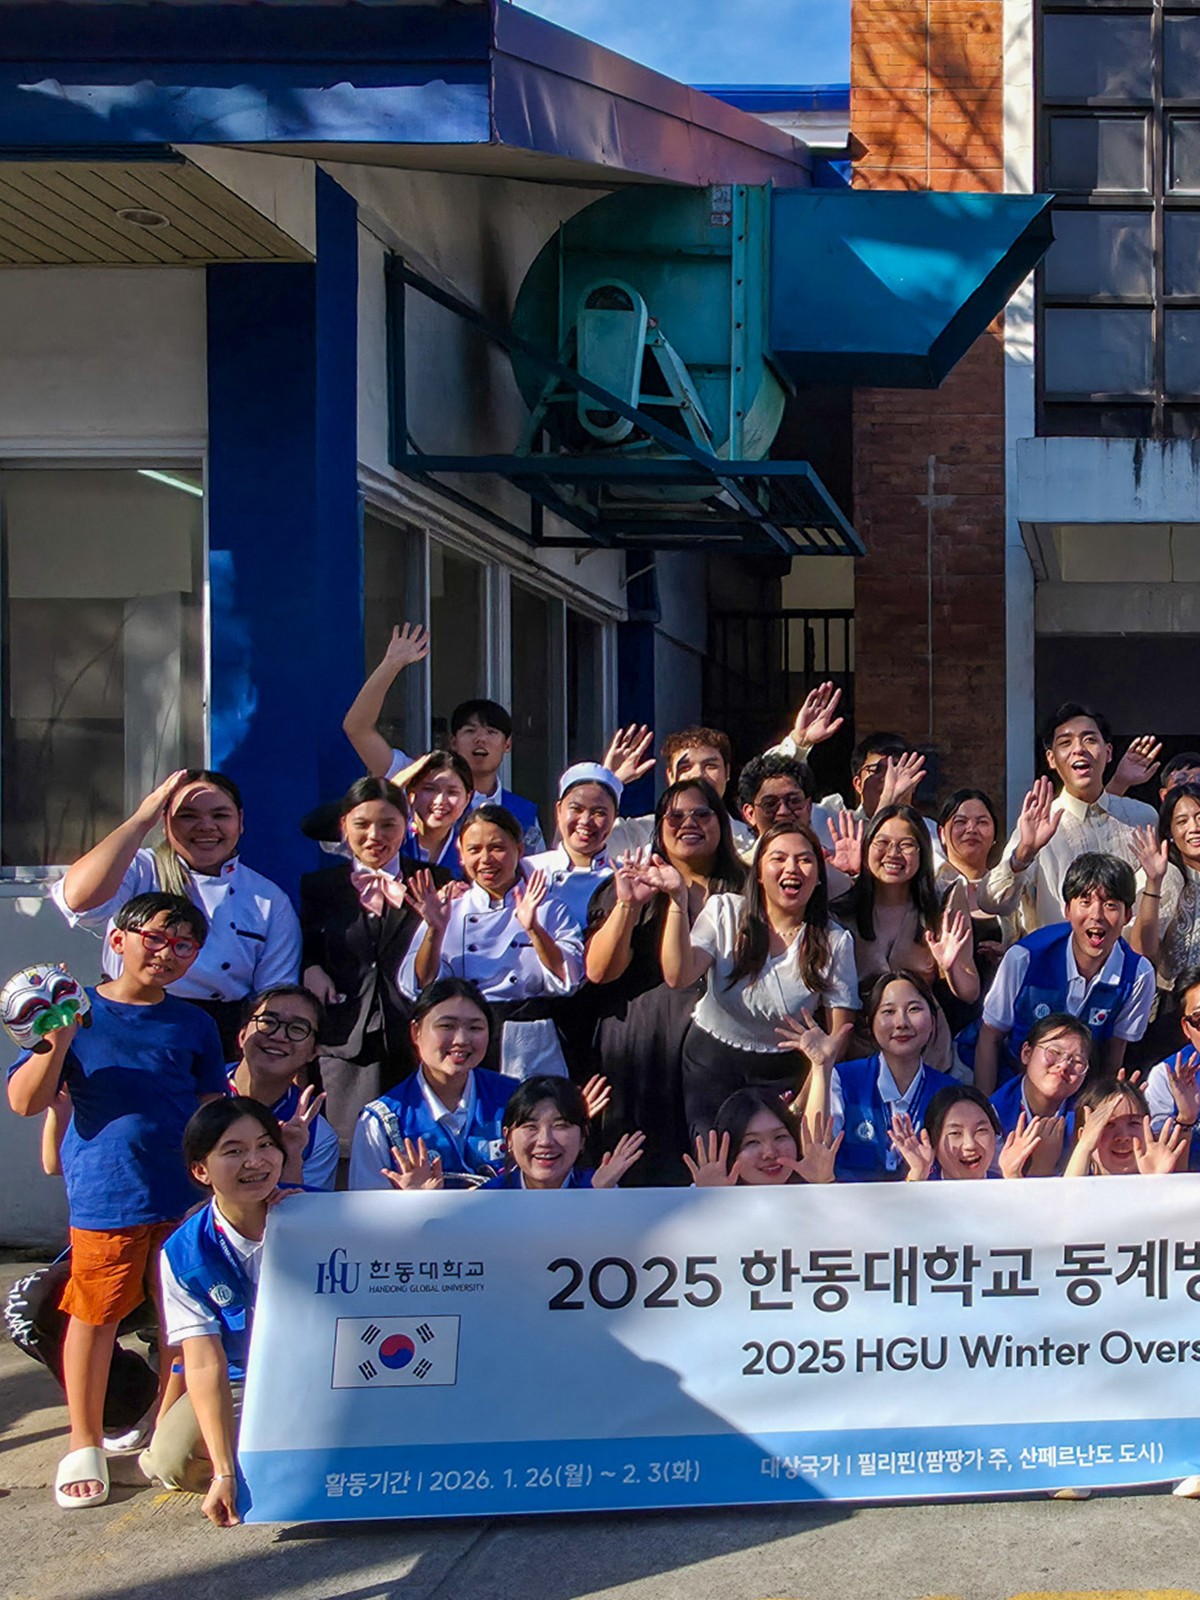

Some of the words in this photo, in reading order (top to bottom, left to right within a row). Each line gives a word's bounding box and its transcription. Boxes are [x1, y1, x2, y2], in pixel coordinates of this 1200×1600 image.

[369, 1284, 408, 1293] HANDONG
[410, 1284, 439, 1293] GLOBAL
[442, 1283, 485, 1292] UNIVERSITY
[370, 1259, 485, 1284] 한동대학교
[547, 1256, 722, 1311] 2025
[740, 1245, 1040, 1313] 한동대학교
[741, 1340, 846, 1376] 2025
[856, 1336, 948, 1372] HGU
[959, 1334, 1091, 1368] Winter
[325, 1470, 411, 1498] 활동기간
[429, 1470, 494, 1492] 2026.
[503, 1468, 517, 1489] 1.
[525, 1463, 593, 1489] 26(월)
[623, 1464, 640, 1484] 2.
[648, 1460, 700, 1483] 3(화)
[761, 1453, 840, 1479] 대상국가
[858, 1449, 983, 1476] 필리핀(팜팡가
[988, 1447, 1013, 1473] 주,
[1019, 1444, 1114, 1469] 산페르난도
[1119, 1442, 1164, 1465] 도시)
